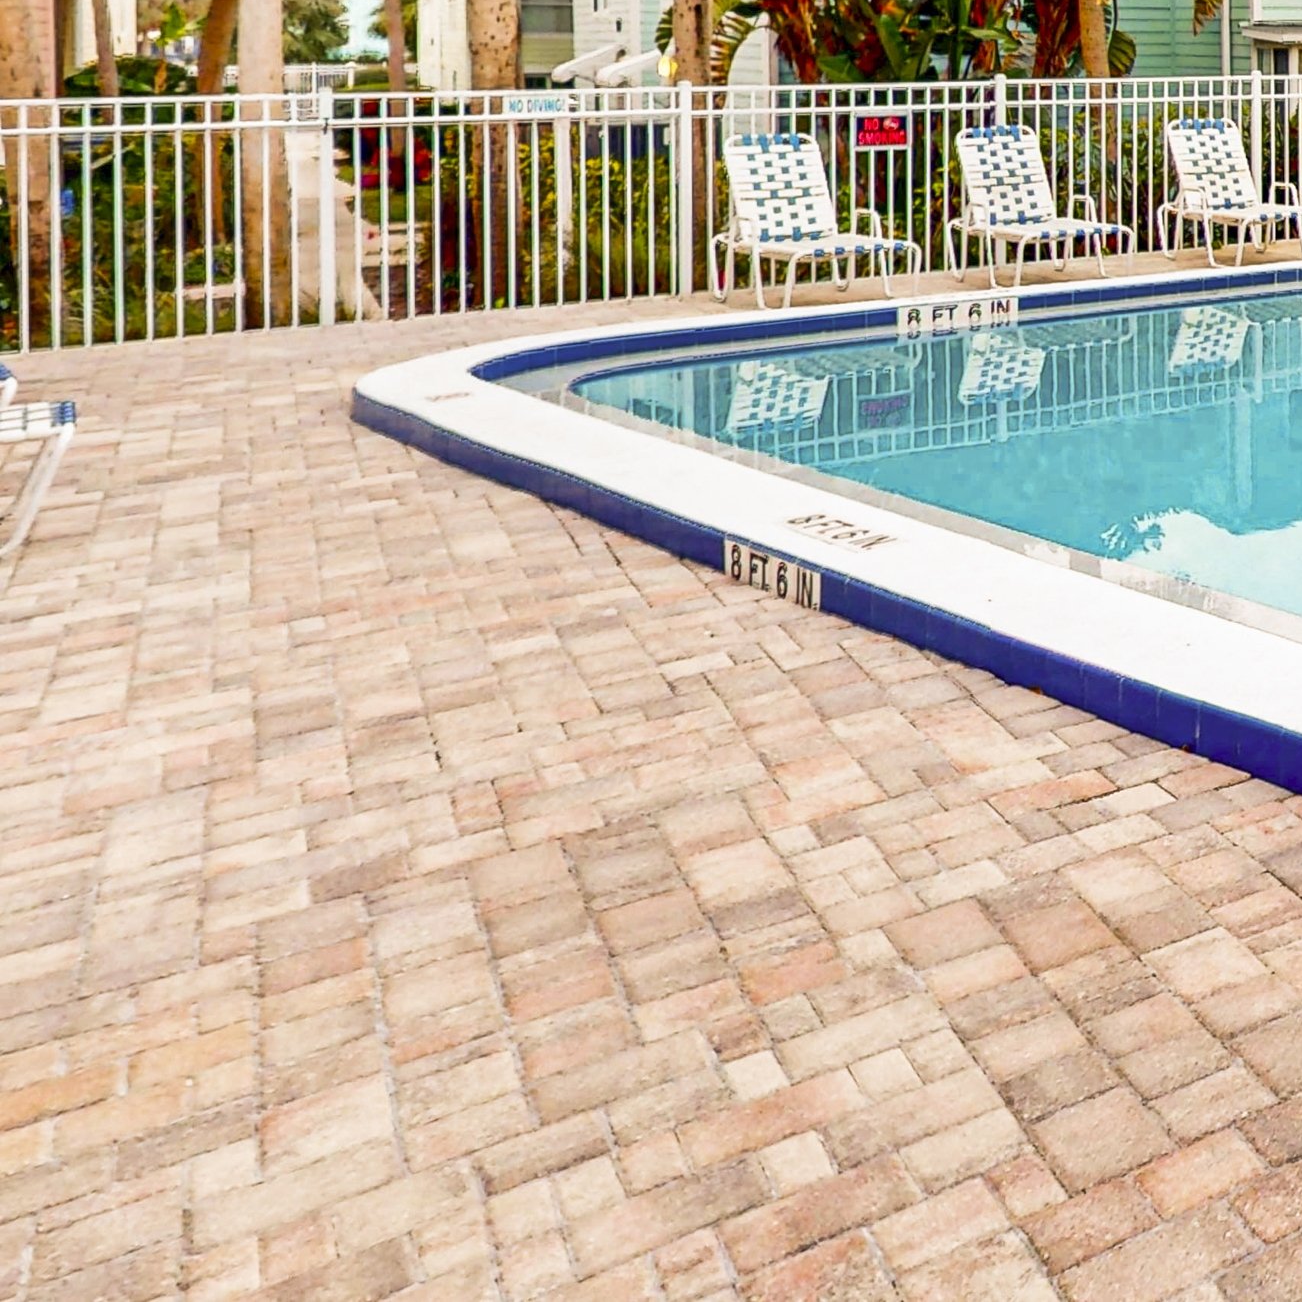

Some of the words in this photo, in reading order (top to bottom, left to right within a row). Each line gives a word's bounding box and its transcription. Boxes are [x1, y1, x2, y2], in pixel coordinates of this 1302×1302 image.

[508, 99, 524, 113] NO
[864, 117, 879, 130] NO
[858, 130, 905, 145] SMOKING
[786, 513, 827, 525] 8
[730, 543, 743, 581] 8
[776, 560, 789, 599] 6
